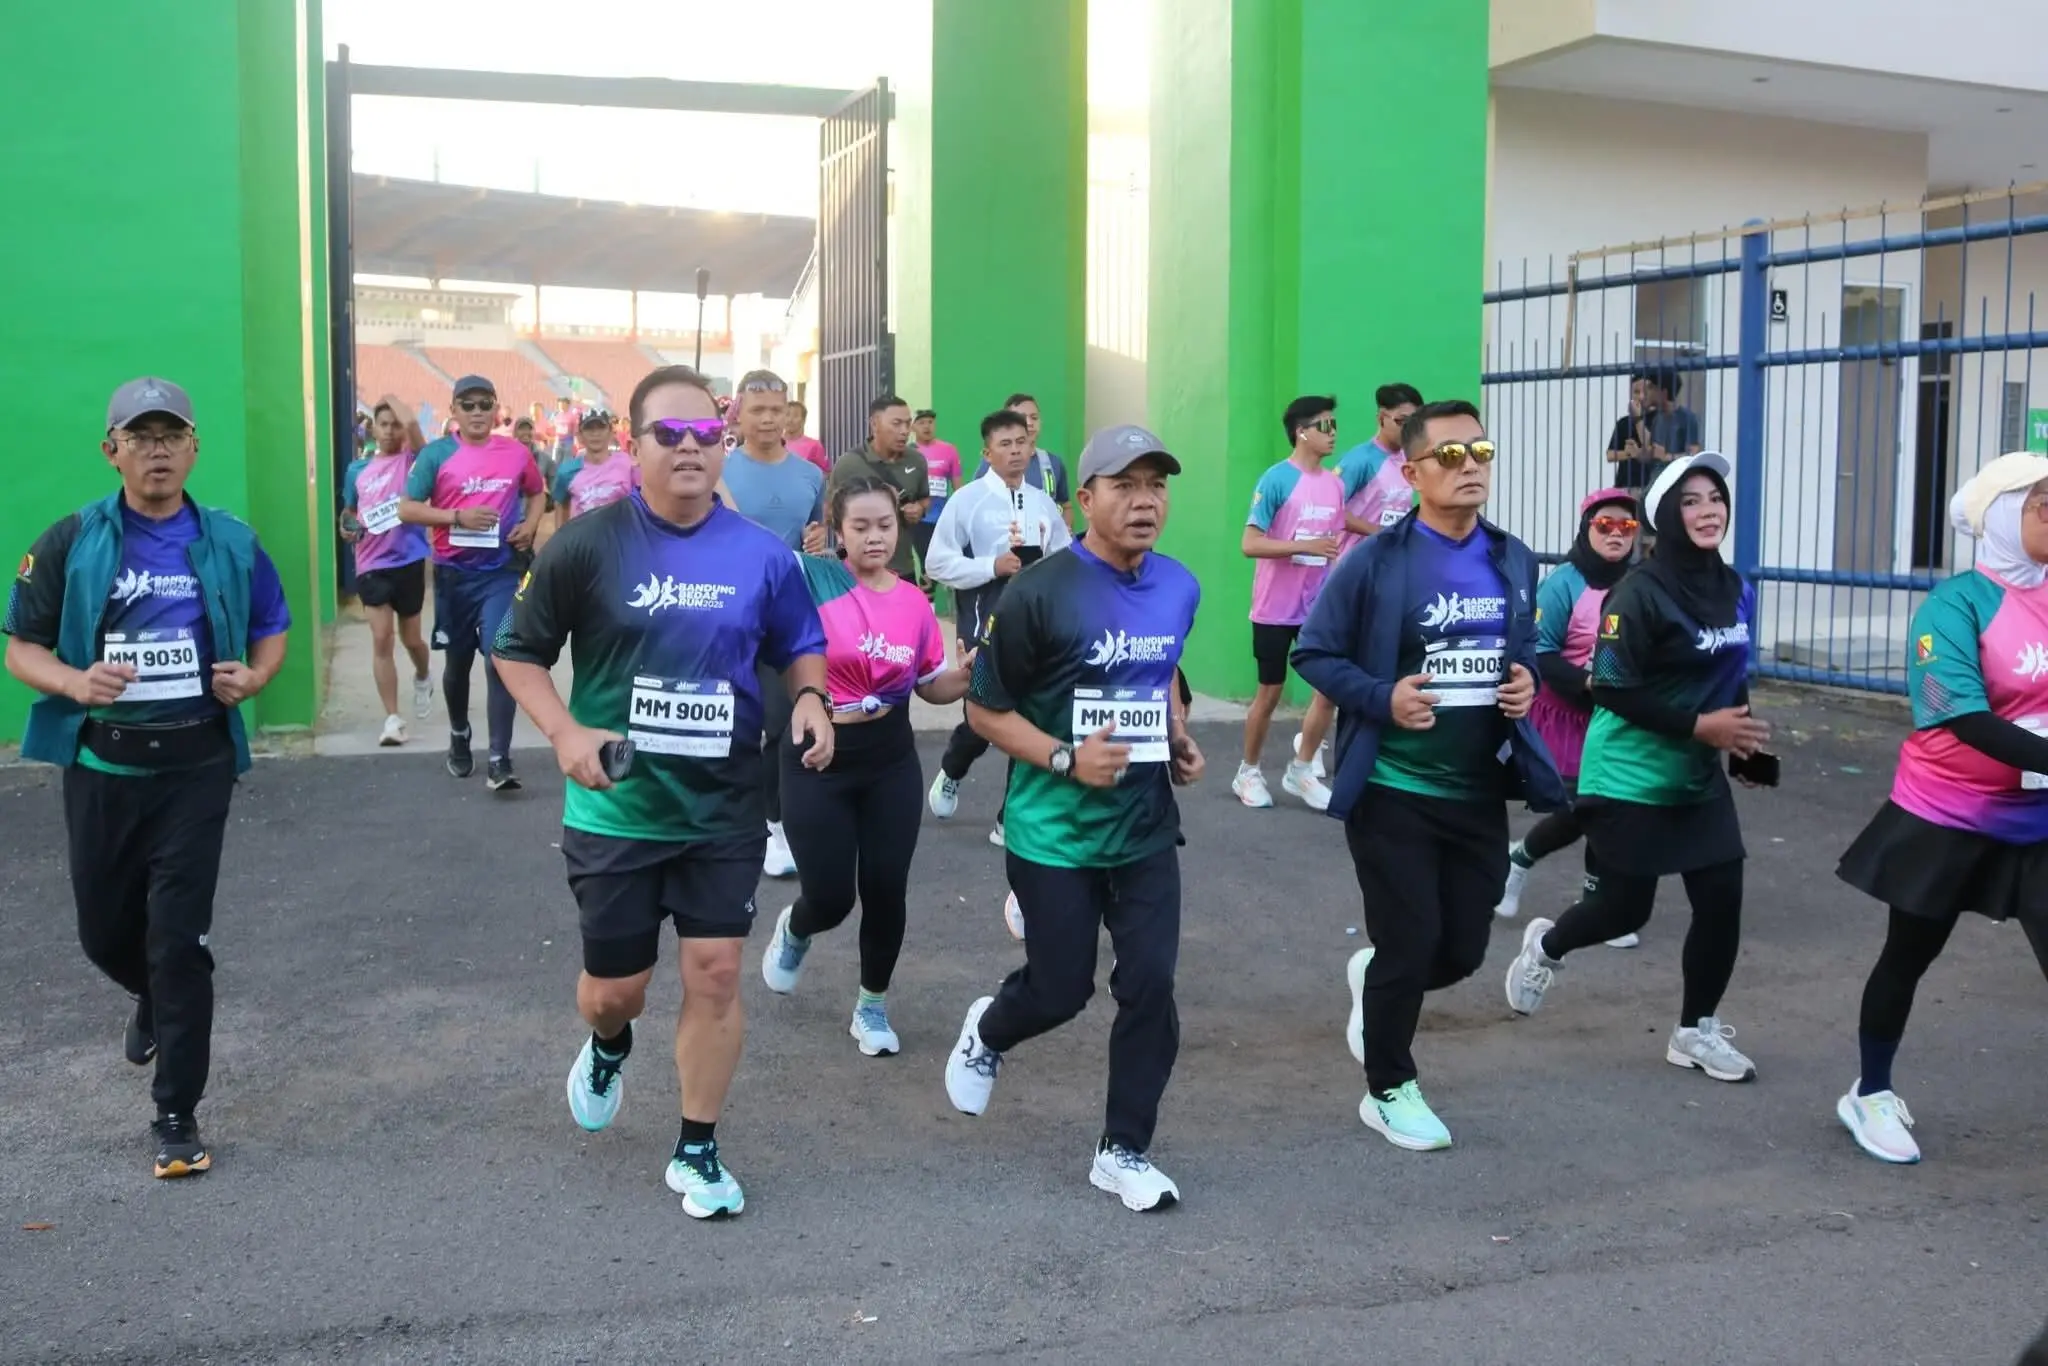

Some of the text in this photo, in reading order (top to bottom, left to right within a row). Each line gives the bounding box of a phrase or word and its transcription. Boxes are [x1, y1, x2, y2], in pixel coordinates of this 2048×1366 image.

[678, 583, 736, 595] BANDUNG
[678, 590, 718, 600] BEDAS
[1129, 636, 1175, 646] BANDUNG
[108, 647, 193, 667] MM 9030
[1426, 657, 1457, 675] MM
[635, 697, 729, 722] MM 9004
[1081, 708, 1160, 728] MM 9001
